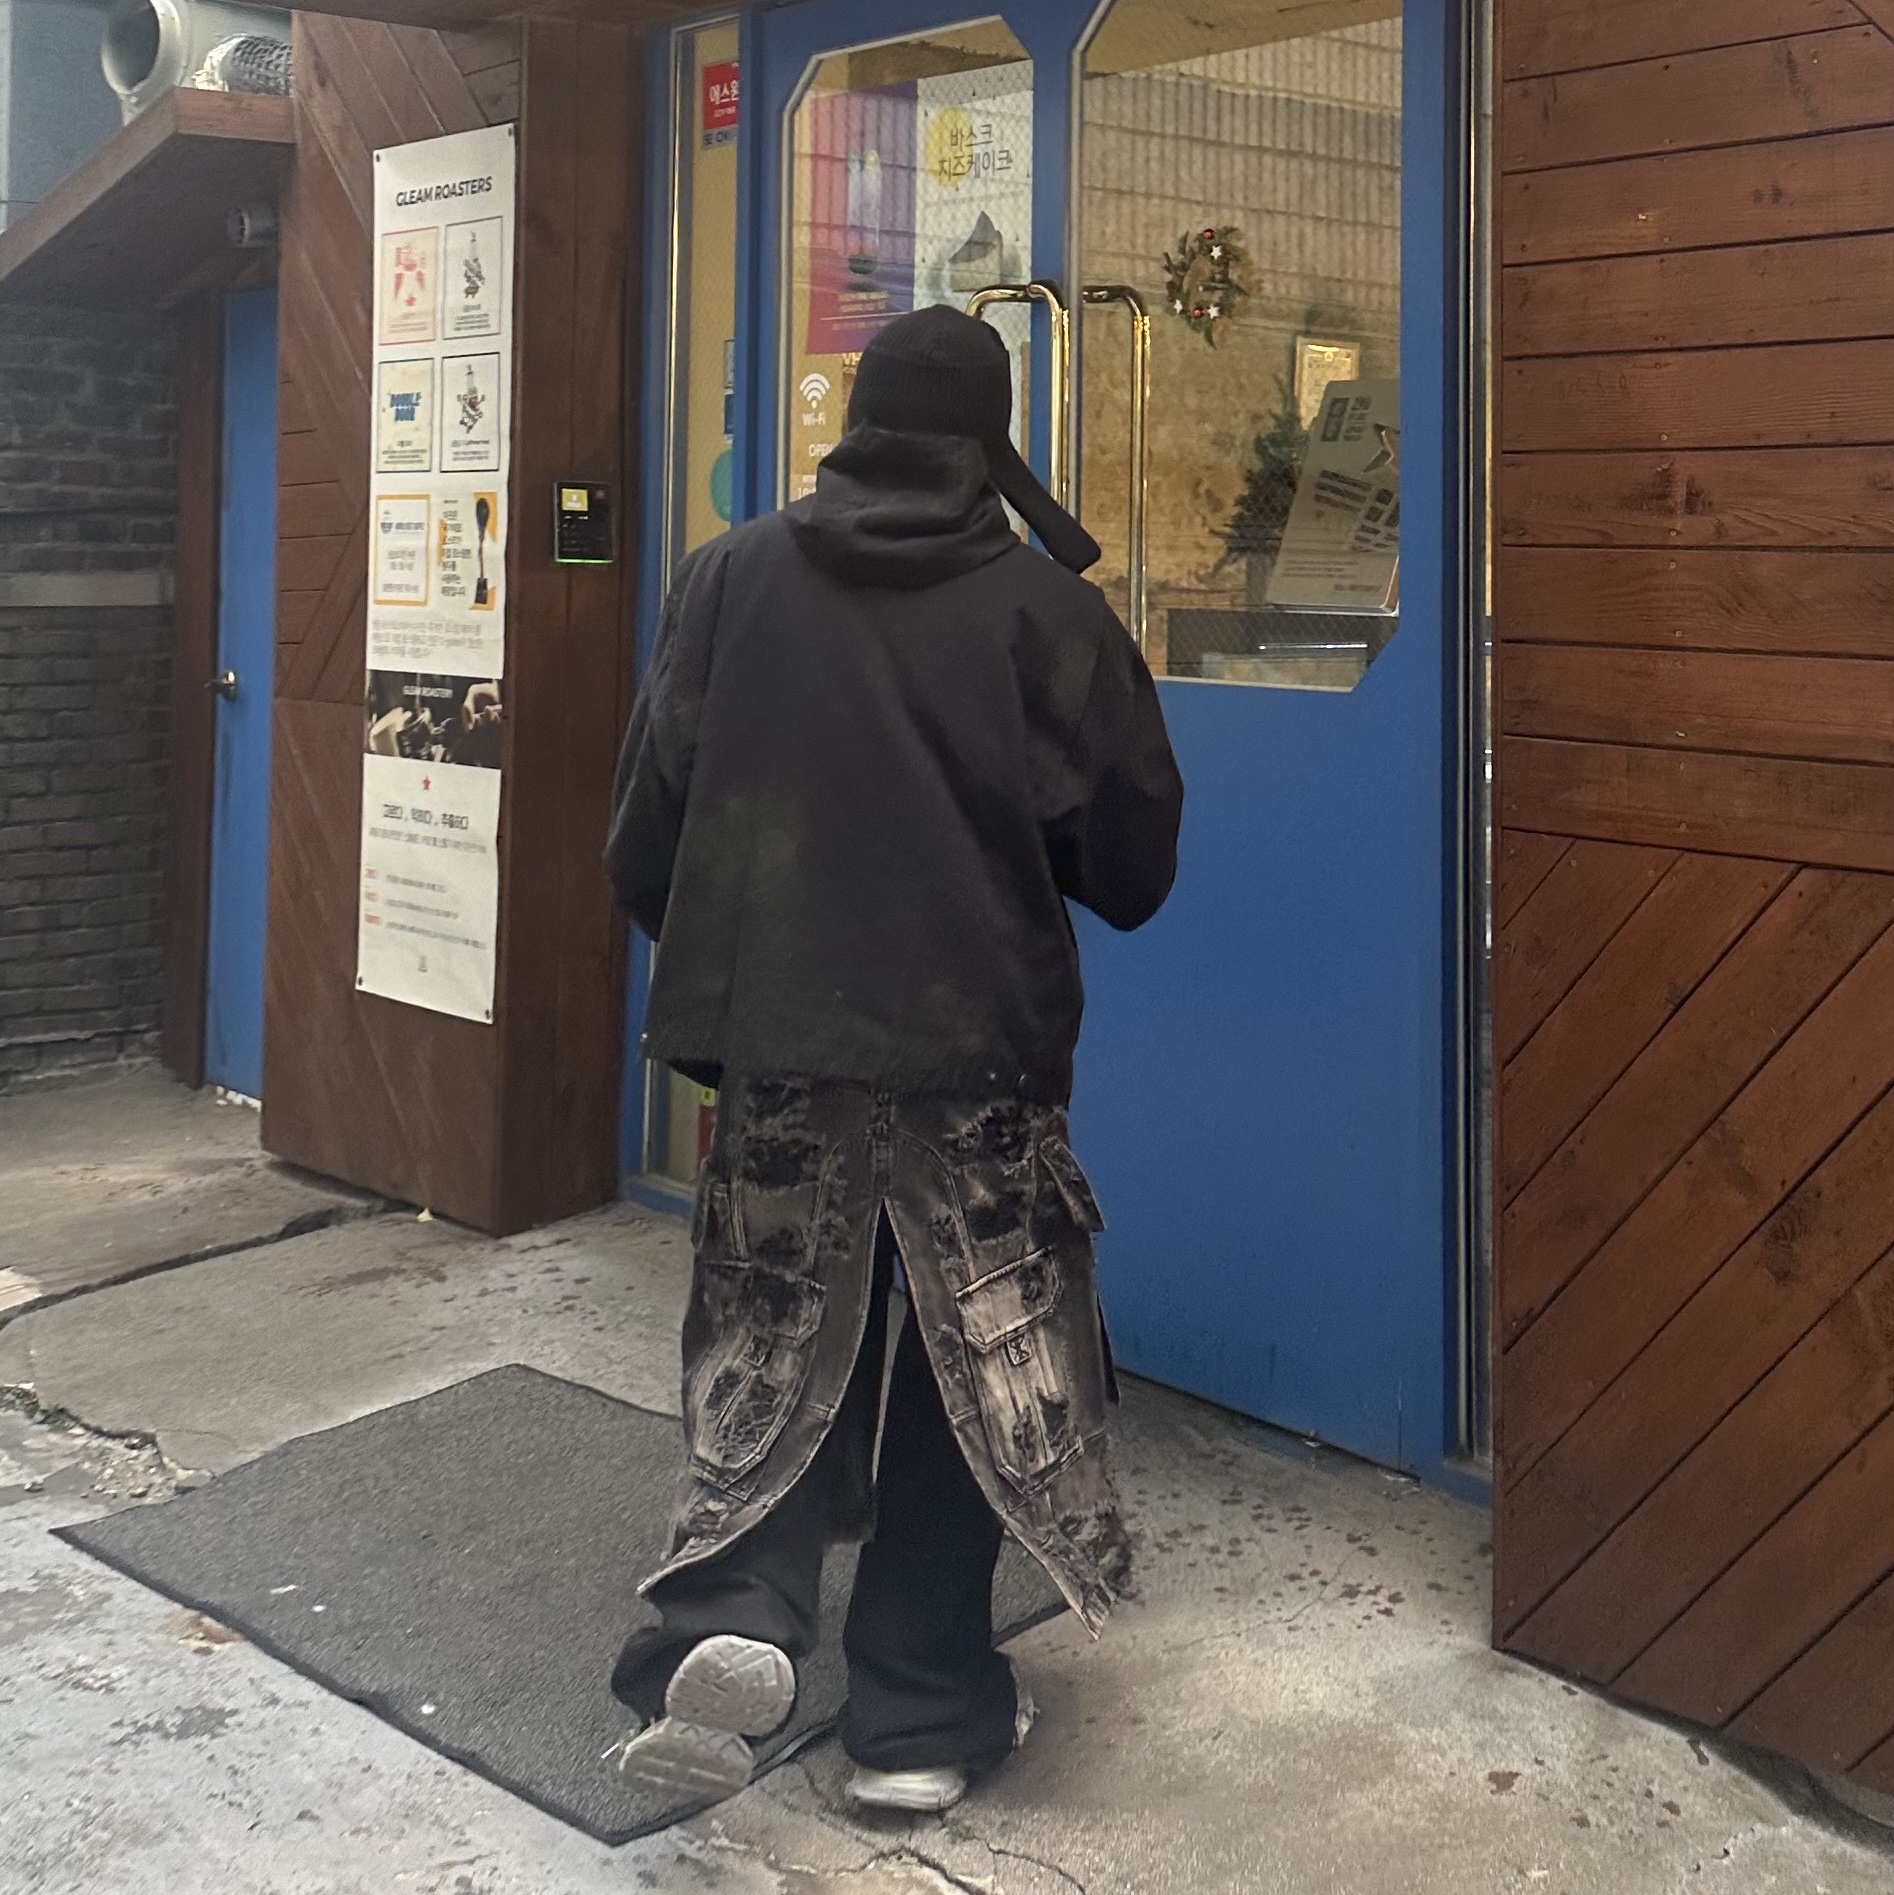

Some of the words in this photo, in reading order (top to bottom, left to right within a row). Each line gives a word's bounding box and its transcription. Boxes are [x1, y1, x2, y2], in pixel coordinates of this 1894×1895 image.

[950, 123, 993, 151] 바스크
[434, 175, 492, 201] ROASTERS
[801, 413, 826, 426] Wi-Fi
